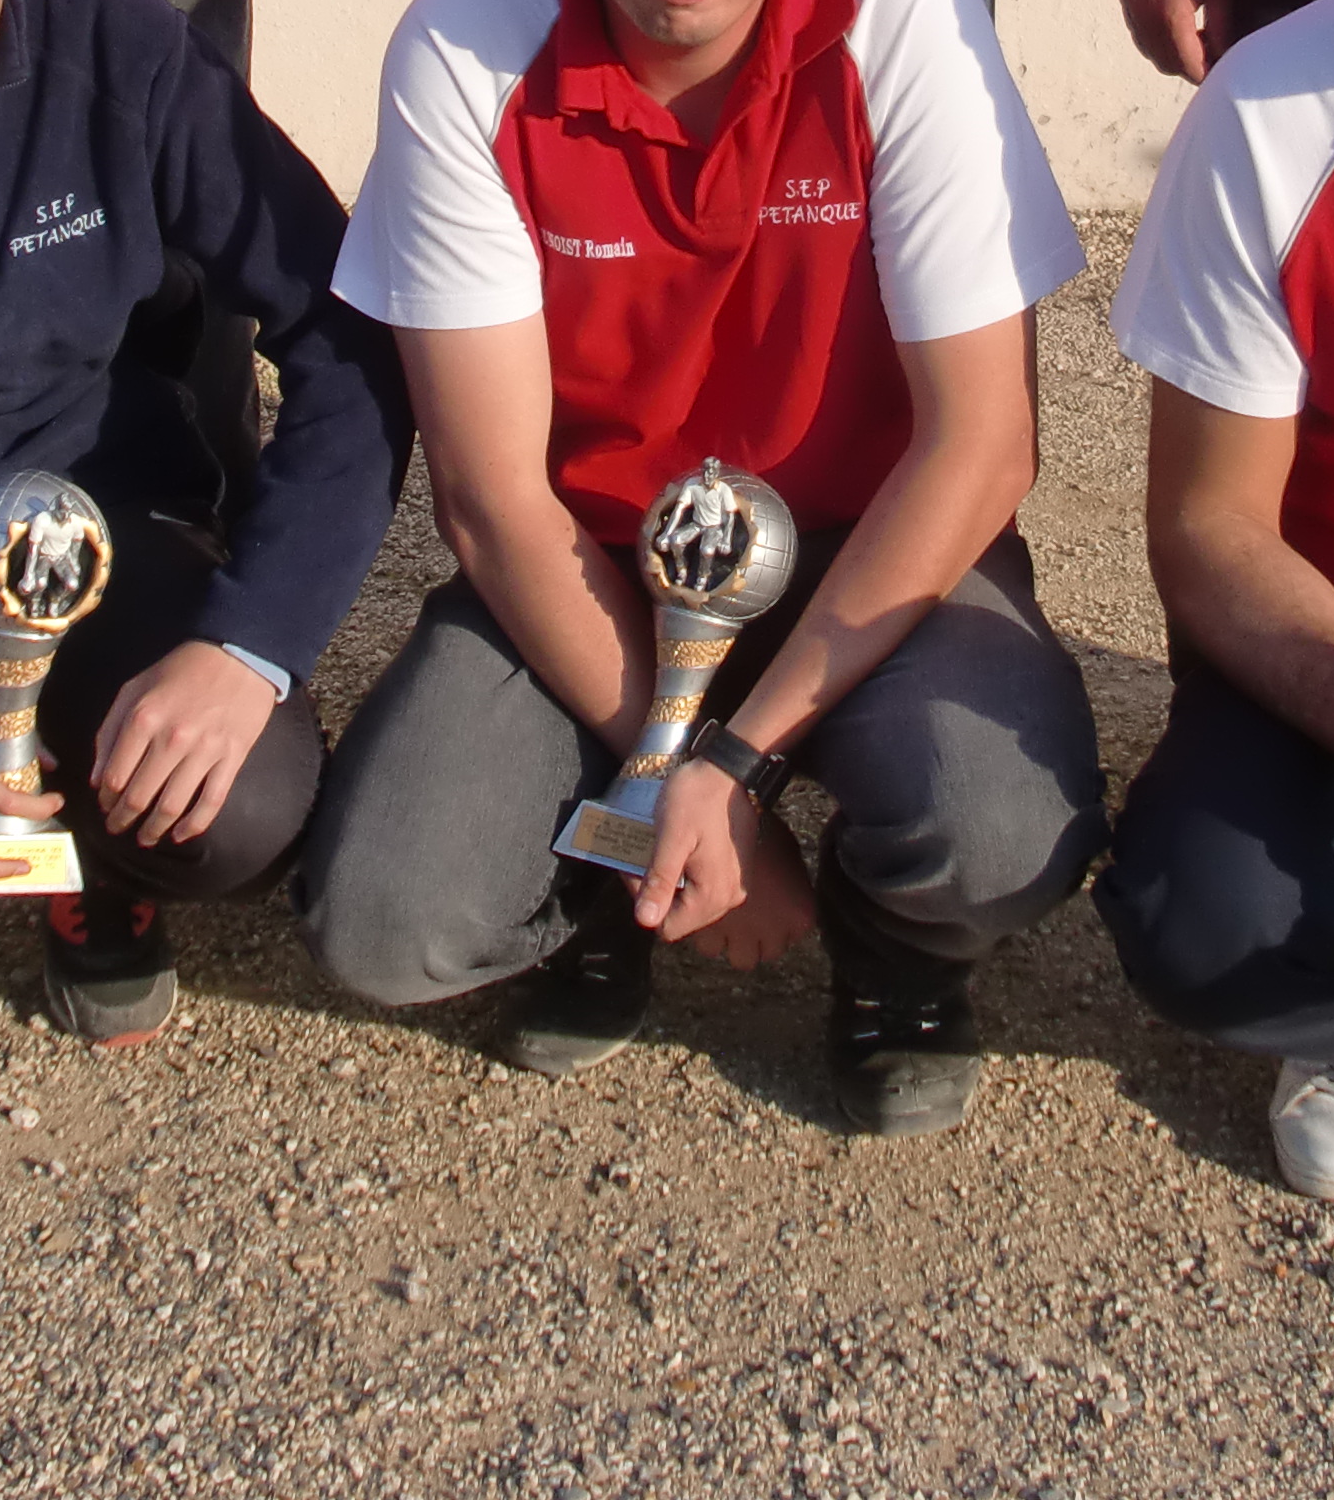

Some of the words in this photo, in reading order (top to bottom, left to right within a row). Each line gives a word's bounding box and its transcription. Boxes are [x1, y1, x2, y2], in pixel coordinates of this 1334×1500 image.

[758, 202, 862, 226] PETANQUE
[9, 208, 107, 258] PETANQUE
[584, 236, 636, 259] Romain
